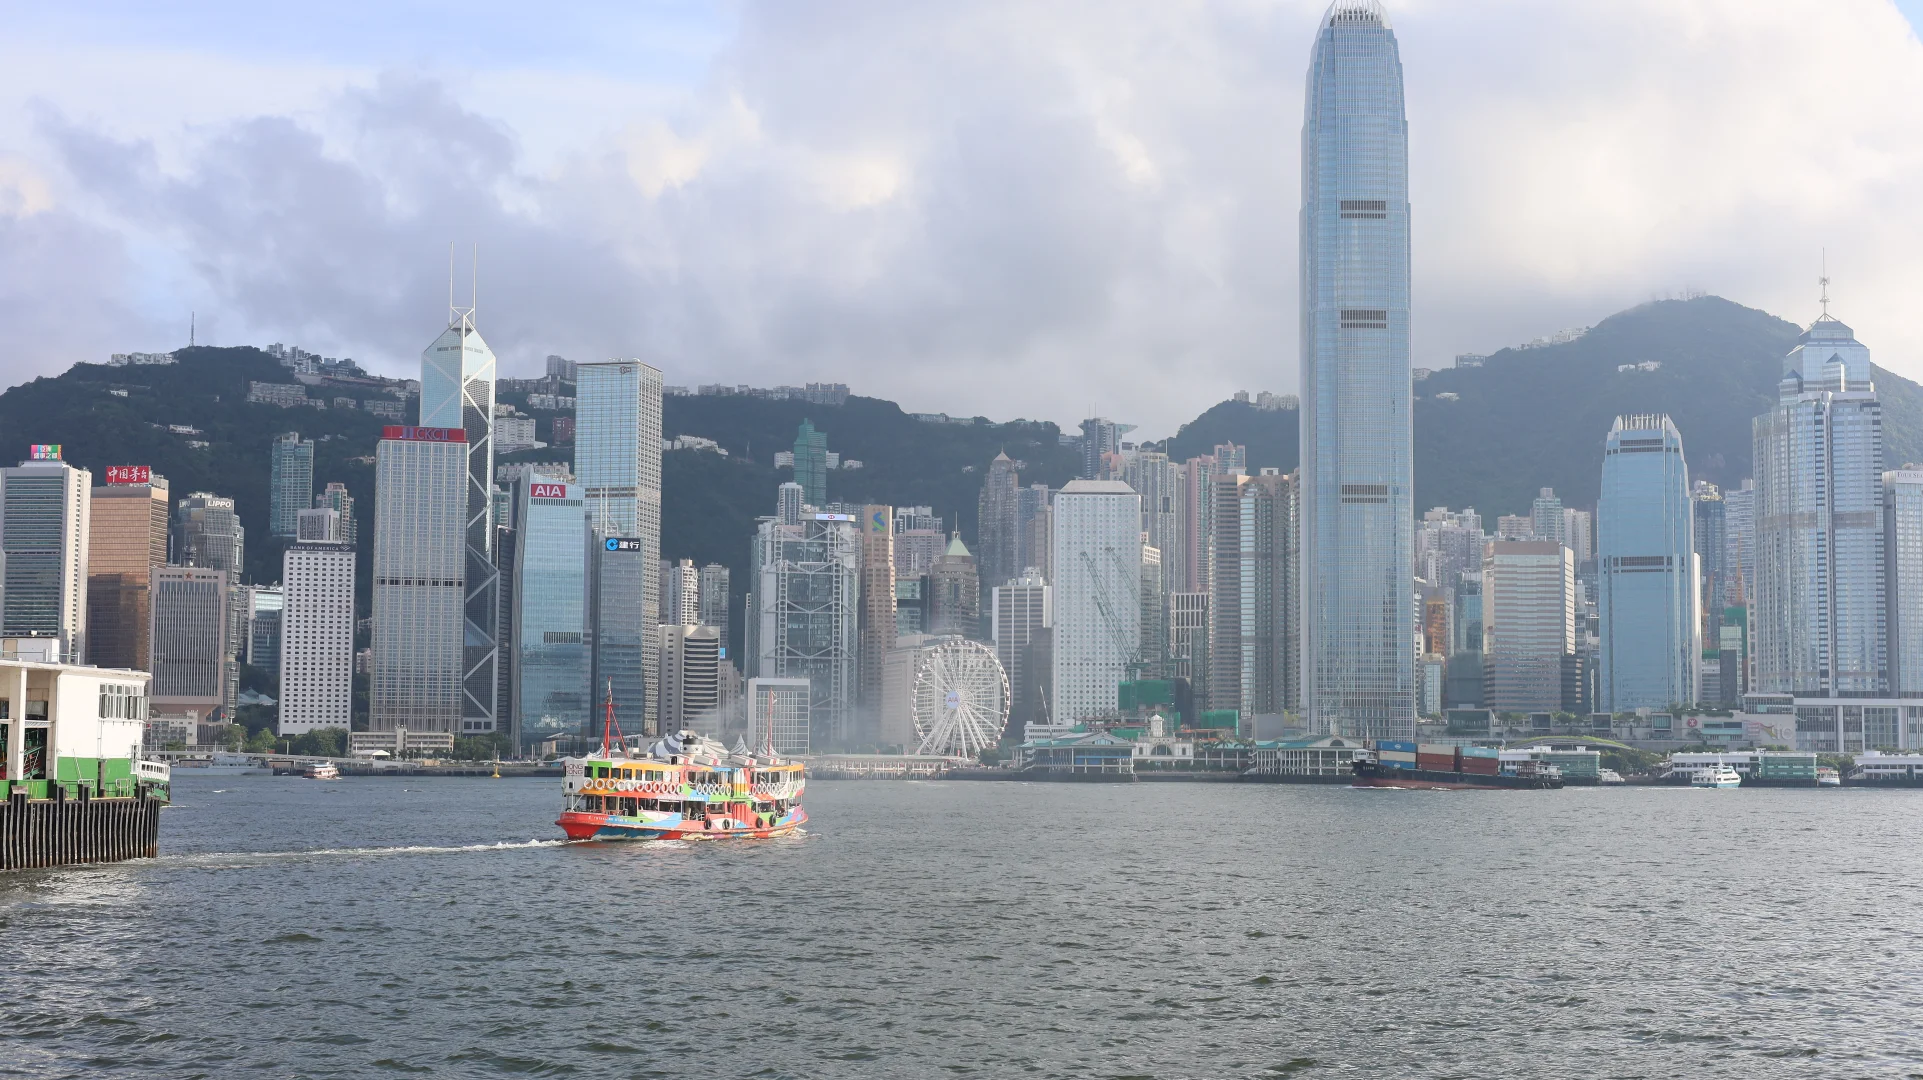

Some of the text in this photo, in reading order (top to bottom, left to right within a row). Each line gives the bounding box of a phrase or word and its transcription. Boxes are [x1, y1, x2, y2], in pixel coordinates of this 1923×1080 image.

[108, 466, 147, 483] 中国茅台
[534, 485, 562, 497] AIA
[207, 500, 232, 508] LIPPO
[618, 540, 640, 550] 建行
